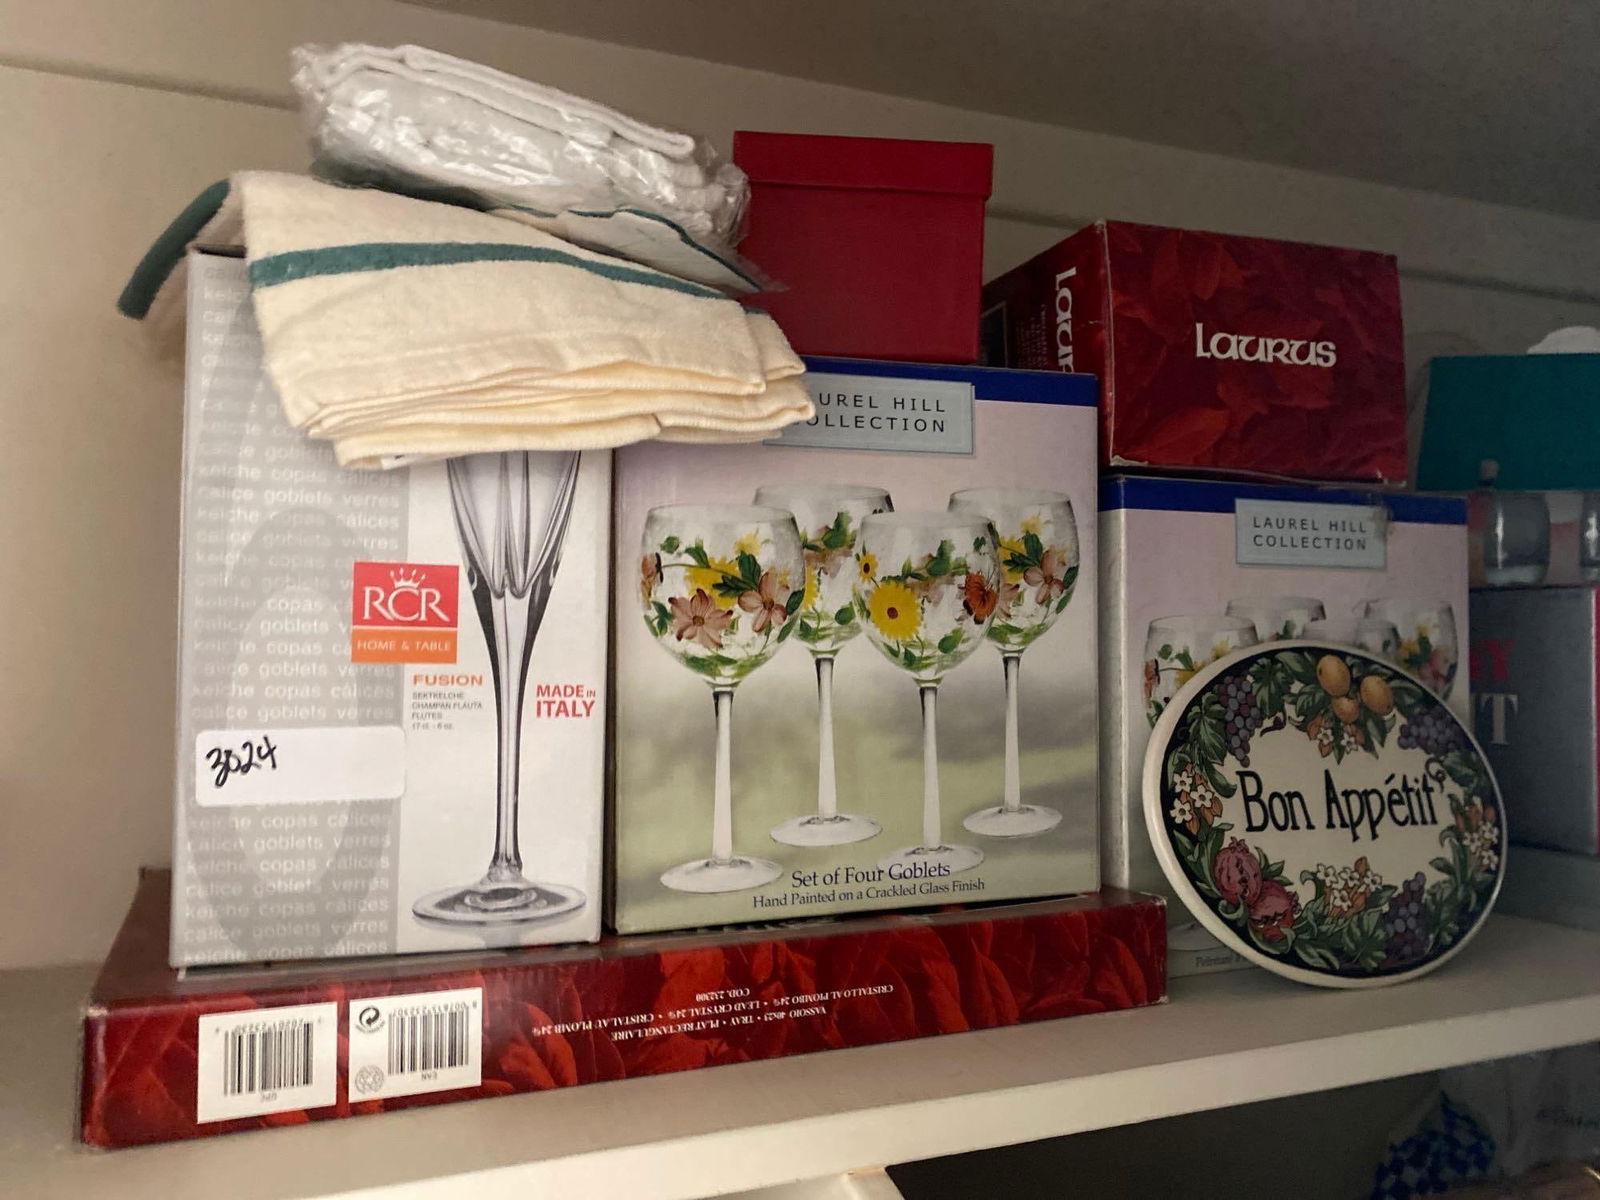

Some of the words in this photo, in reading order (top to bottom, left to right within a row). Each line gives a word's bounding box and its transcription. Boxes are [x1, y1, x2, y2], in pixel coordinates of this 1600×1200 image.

[818, 391, 879, 409] UREL
[893, 397, 945, 413] HILL
[793, 414, 945, 433] OLLECTION
[1253, 516, 1319, 531] LAUREL
[1329, 520, 1367, 533] HILL
[1253, 534, 1367, 550] COLLECTION
[363, 586, 449, 622] RCR
[357, 640, 396, 651] HOME
[401, 641, 410, 651] &
[415, 641, 450, 651] TABLE
[413, 674, 483, 686] FUSION
[536, 684, 584, 698] MADE
[586, 690, 596, 698] IN
[536, 700, 596, 718] ITALY
[1235, 770, 1315, 833] Bon
[1324, 767, 1439, 843] Appétit
[791, 870, 818, 888] Set
[822, 868, 839, 886] of
[844, 866, 884, 885] Four
[888, 862, 951, 881] Goblets
[753, 893, 788, 909] Hand
[791, 890, 836, 905] Painted
[838, 891, 854, 901] on
[856, 891, 863, 900] a
[866, 884, 917, 899] Crackled
[919, 882, 950, 895] Glass
[952, 879, 985, 892] Finish
[727, 988, 750, 998] COD.
[791, 992, 829, 1004] PIOMBO
[844, 985, 894, 998] CRISTALLO
[689, 1004, 733, 1017] CRYSTAL
[734, 1000, 760, 1012] LEAD
[613, 1012, 654, 1027] CRISTAL
[693, 1019, 720, 1032] PLAT
[730, 1015, 754, 1026] TRAY
[555, 1020, 592, 1035] PLOMB
[611, 1023, 693, 1042] RECTANGULAIRE
